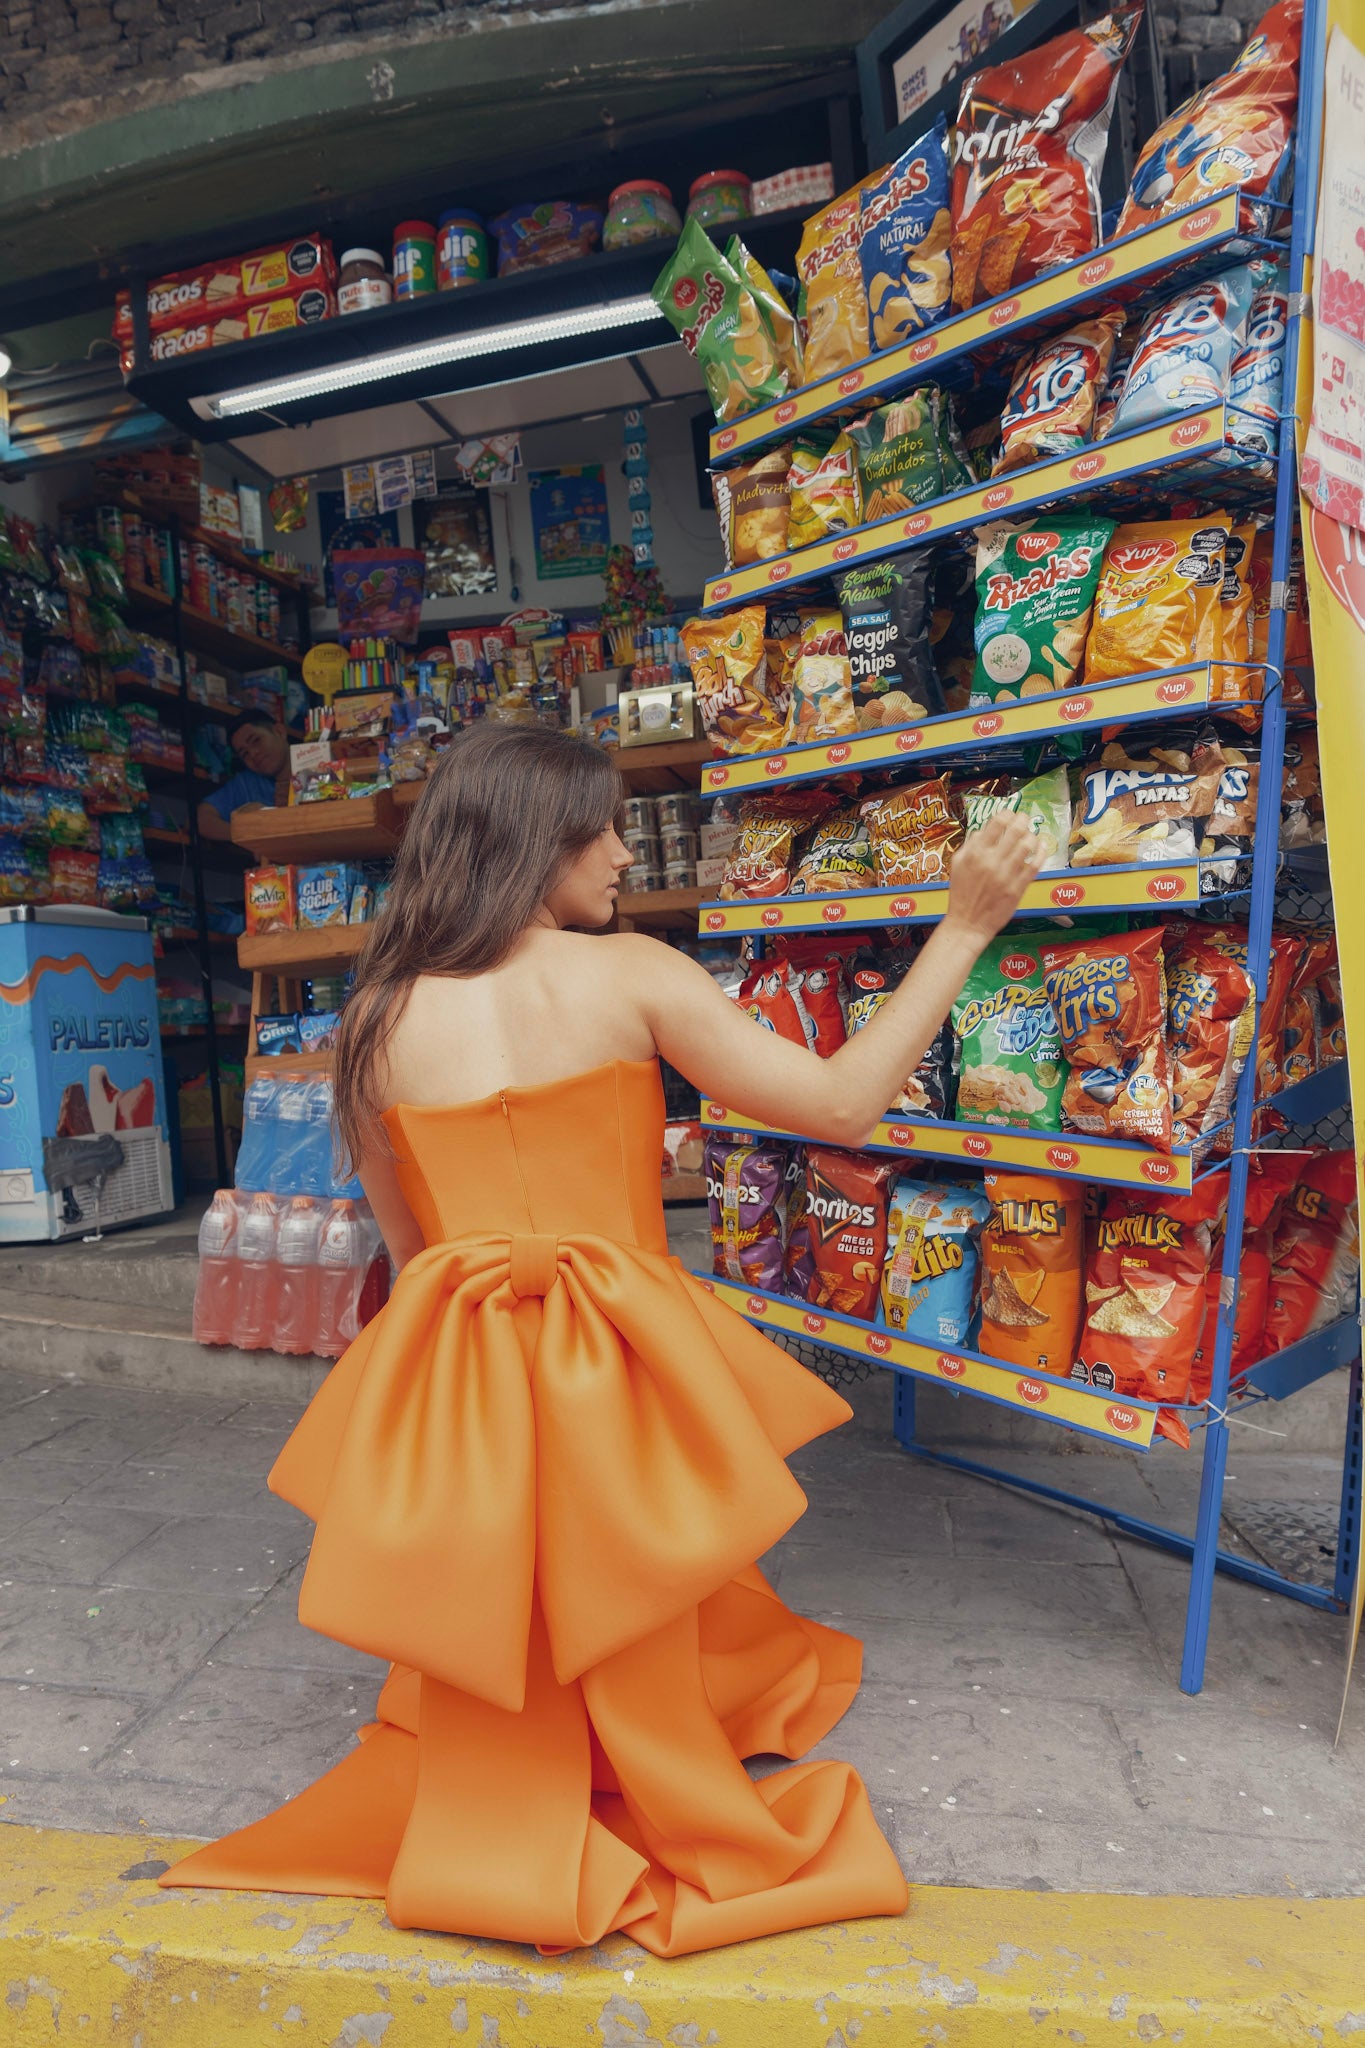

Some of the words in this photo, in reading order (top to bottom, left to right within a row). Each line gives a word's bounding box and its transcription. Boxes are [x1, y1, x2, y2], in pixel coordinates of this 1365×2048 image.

[1188, 213, 1210, 230] Yupi
[880, 221, 926, 250] NATURAL
[439, 235, 478, 262] Jif
[245, 261, 263, 286] 7
[1085, 262, 1106, 277] Yupi
[995, 304, 1013, 318] Yupi
[252, 306, 270, 333] 7
[915, 342, 930, 354] Yupi
[843, 376, 858, 387] Yupi
[778, 407, 792, 417] Yupi
[1177, 422, 1200, 437] Yupi
[720, 434, 732, 443] Yupi
[866, 454, 926, 481] Ondulados
[1077, 458, 1097, 472] Yupi
[988, 491, 1006, 502] Yupi
[909, 518, 925, 529] Yupi
[838, 542, 852, 553] Yupi
[1022, 537, 1049, 549] Yupi
[1124, 543, 1163, 562] Yupi
[773, 565, 786, 575] Yupi
[843, 562, 896, 590] Sensibly
[715, 586, 727, 595] Yupi
[839, 577, 893, 606] Natural
[1050, 586, 1081, 600] Cream
[851, 617, 869, 626] SEA
[871, 612, 889, 624] SALT
[844, 622, 898, 654] Veggie
[850, 652, 897, 677] Chips
[1163, 682, 1186, 694] Yupi
[1066, 700, 1085, 712] Yupi
[979, 718, 996, 729] Yupi
[901, 733, 916, 743] Yupi
[832, 748, 846, 757] Yupi
[768, 760, 782, 769] Yupi
[1134, 786, 1189, 805] PAPAS
[818, 857, 866, 876] Limón
[303, 878, 333, 897] CLUB
[1154, 880, 1176, 891] Yupi
[249, 886, 286, 905] belVita
[1057, 888, 1076, 899] Yupi
[299, 891, 339, 910] SOCIAL
[894, 901, 910, 910] Yupi
[765, 911, 778, 920] Yupi
[826, 906, 840, 915] Yupi
[1006, 960, 1027, 969] Yupi
[861, 973, 879, 984] Yupi
[1046, 956, 1129, 1000] Cheese
[50, 1015, 151, 1051] PALETAS
[259, 1025, 296, 1042] OREO
[1029, 1048, 1062, 1064] Limó
[710, 1106, 722, 1115] Yupi
[892, 1129, 908, 1139] Yupi
[968, 1139, 985, 1150] Yupi
[1052, 1150, 1072, 1161] Yupi
[1147, 1162, 1169, 1174] Yupi
[841, 1234, 873, 1247] MEGA
[838, 1243, 875, 1256] QUESO
[751, 1299, 762, 1308] Yupi
[808, 1316, 820, 1327] Yupi
[938, 1322, 959, 1339] 130g
[871, 1336, 886, 1347] Yupi
[943, 1358, 960, 1370] Yupi
[1023, 1382, 1042, 1395] Yupi
[1113, 1409, 1133, 1424] Yupi
